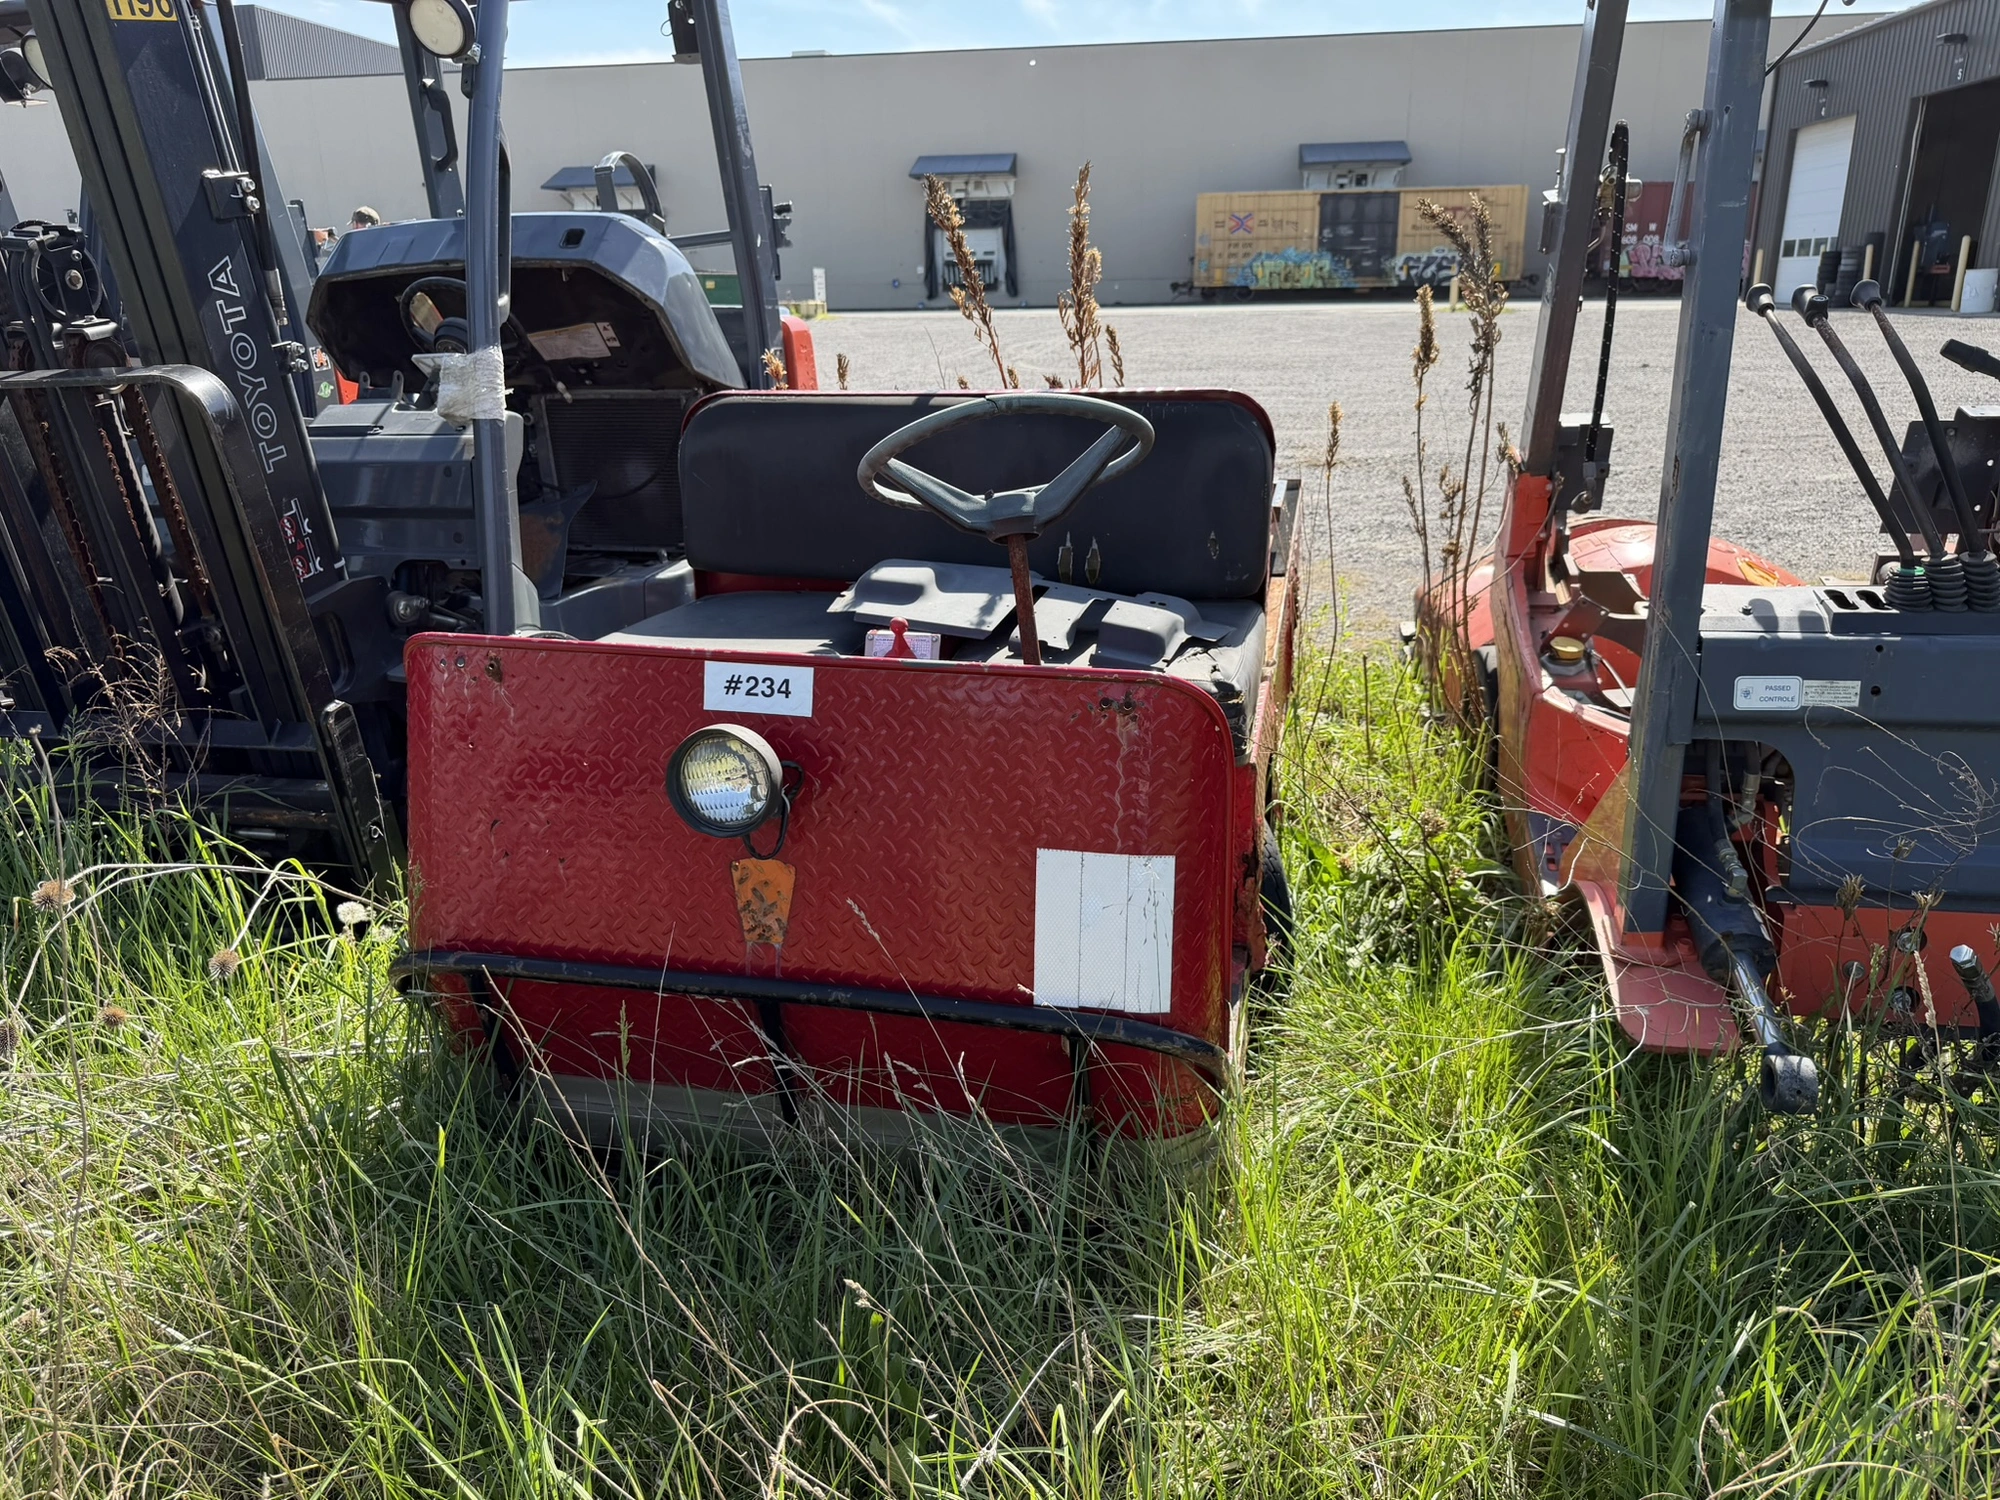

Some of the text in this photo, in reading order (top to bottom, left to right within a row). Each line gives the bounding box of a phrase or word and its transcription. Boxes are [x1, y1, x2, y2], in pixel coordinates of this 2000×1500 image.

[1957, 68, 1963, 80] 5
[207, 255, 288, 474] TOYOTA
[723, 674, 792, 699] #234
